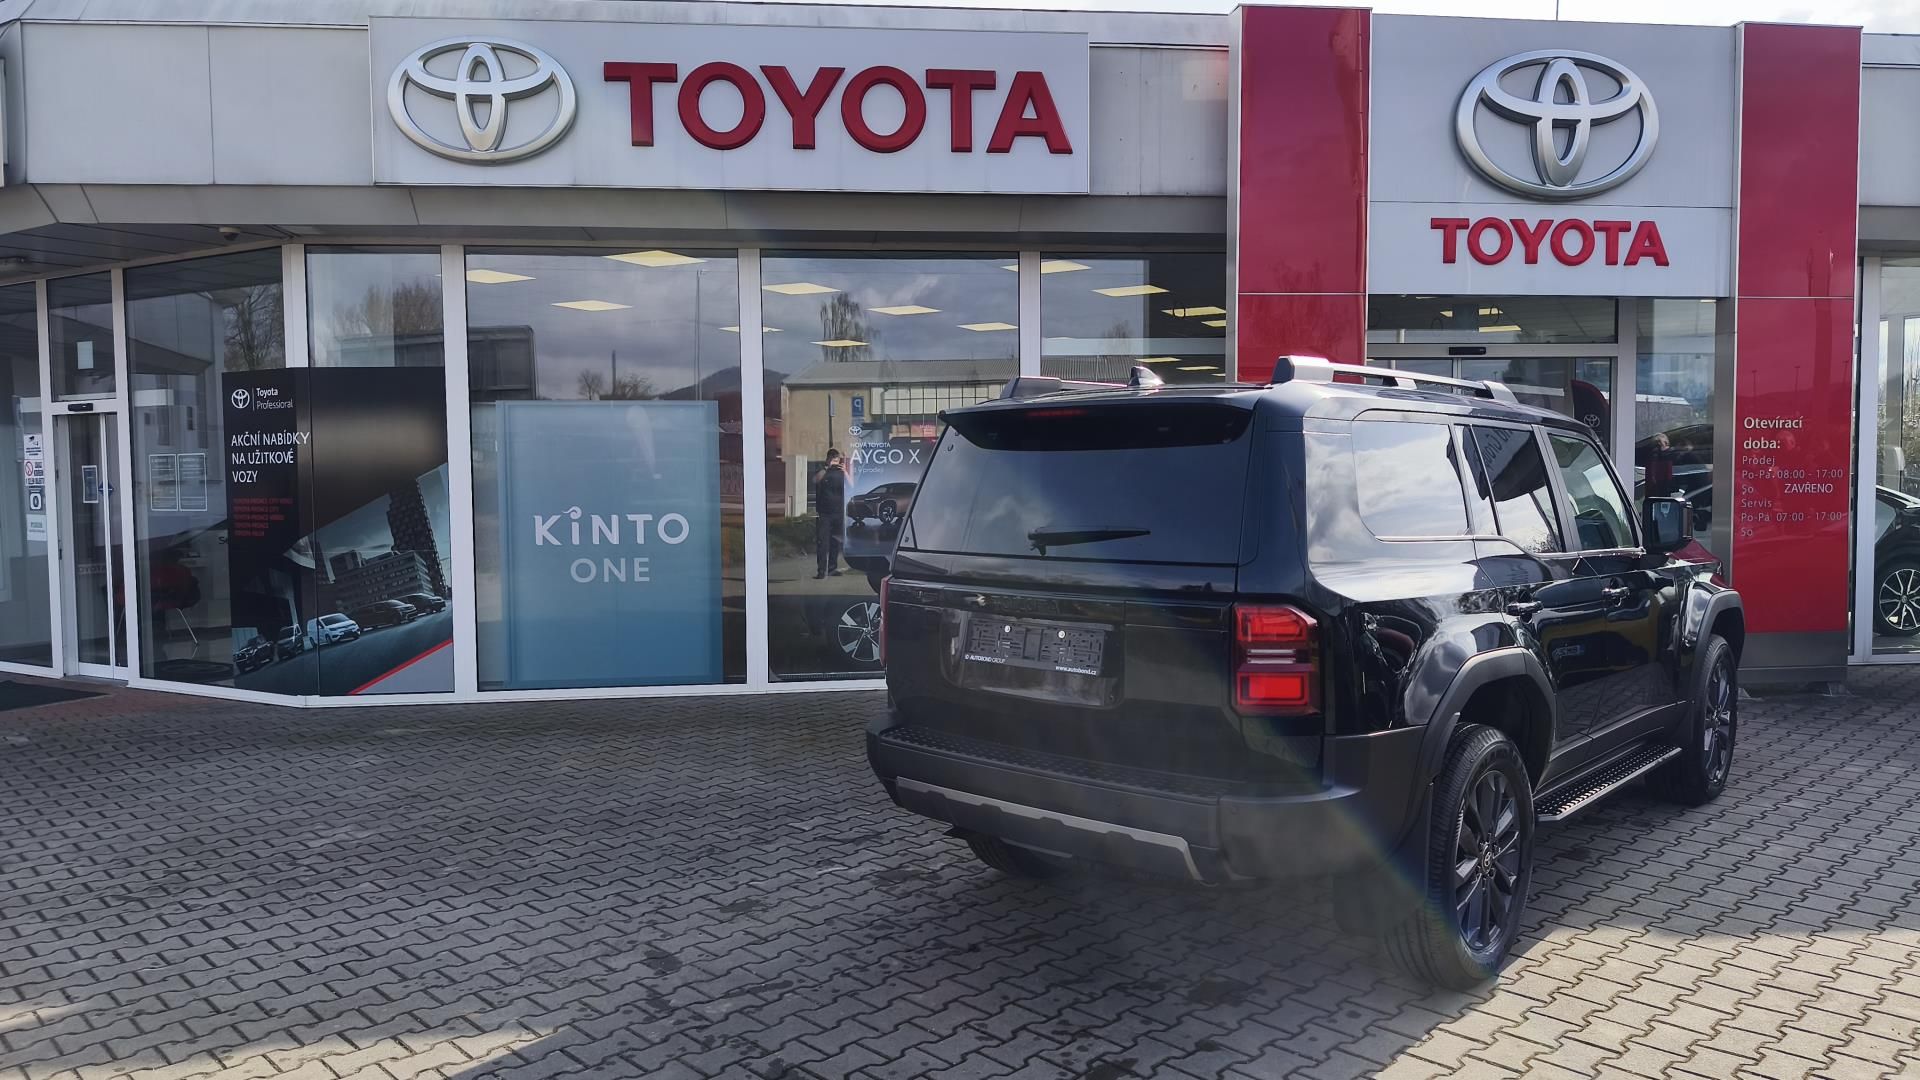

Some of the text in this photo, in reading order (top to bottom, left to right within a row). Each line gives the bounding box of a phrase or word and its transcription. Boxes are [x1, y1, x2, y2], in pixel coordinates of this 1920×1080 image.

[603, 60, 1074, 155] TOYOTA
[1430, 217, 1670, 267] TOYOTA
[256, 387, 278, 398] Toyota
[256, 398, 293, 410] Professional
[1744, 415, 1803, 429] Otevírací
[231, 429, 310, 446] AKČNÍ NABÍDKY
[1743, 437, 1781, 449] doba:
[232, 447, 294, 465] NA UŽITKOVÉ
[850, 449, 920, 464] AYGO X
[1742, 455, 1775, 467] Prodej
[232, 470, 258, 483] VOZY
[1777, 469, 1805, 479] 08:00
[1816, 469, 1843, 478] 17:00
[1742, 481, 1833, 493] So ZAVŘENO
[1741, 498, 1772, 508] Servis
[1776, 512, 1804, 521] 07:00
[1815, 511, 1842, 521] 17:00
[1741, 527, 1753, 537] So
[570, 557, 650, 583] ONE
